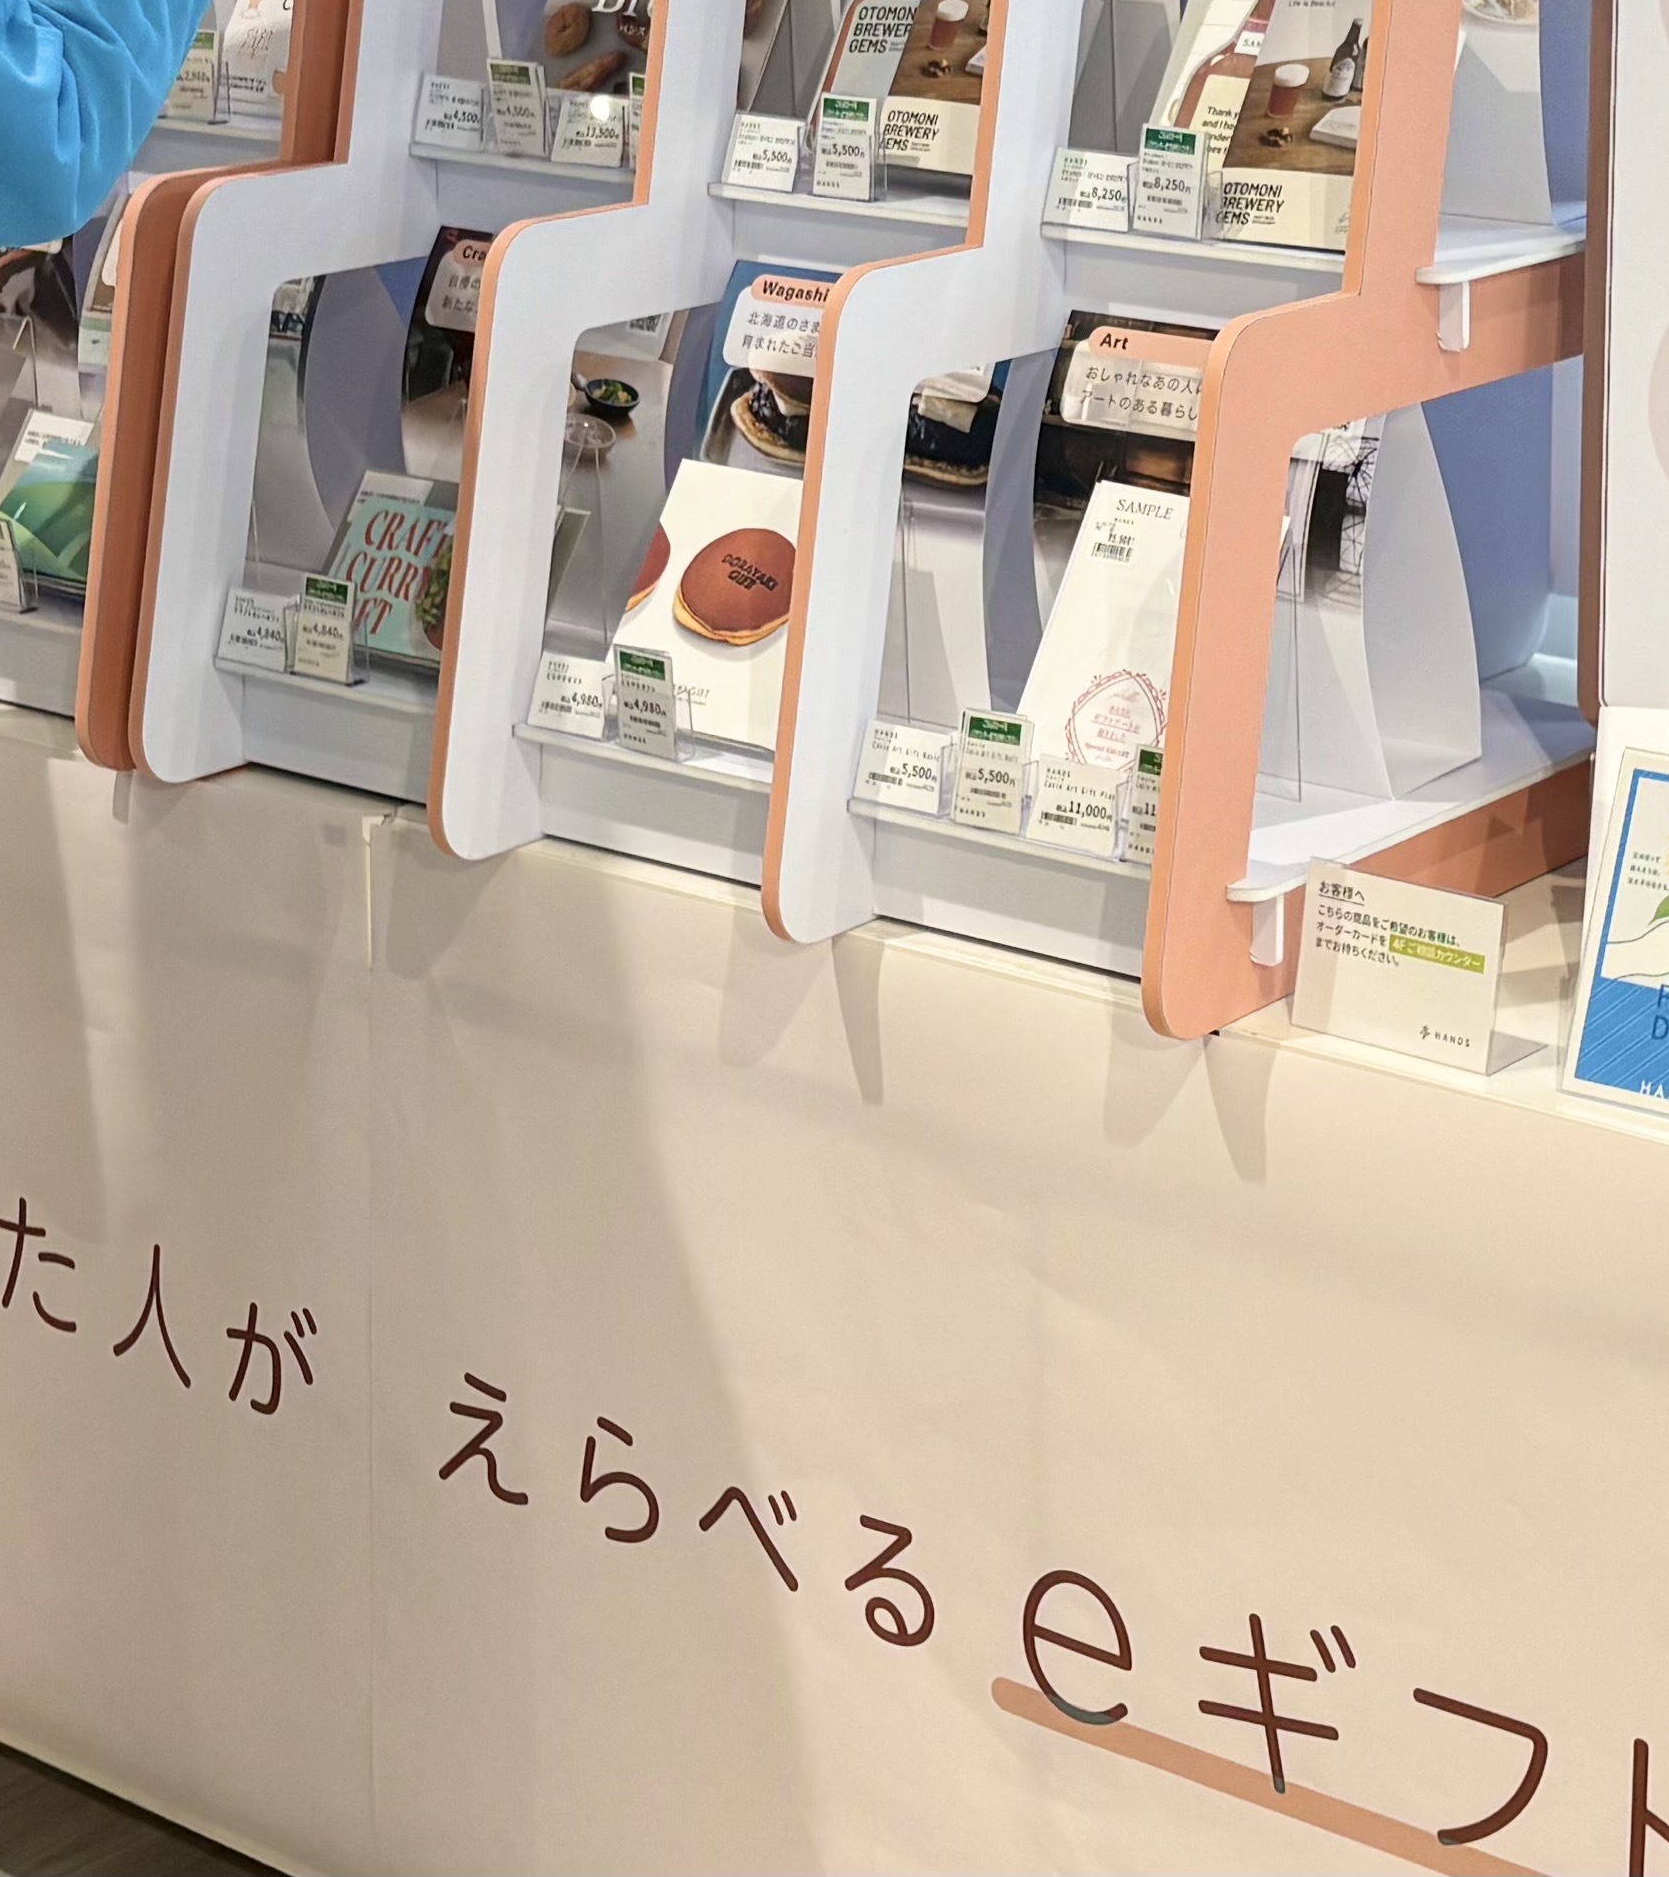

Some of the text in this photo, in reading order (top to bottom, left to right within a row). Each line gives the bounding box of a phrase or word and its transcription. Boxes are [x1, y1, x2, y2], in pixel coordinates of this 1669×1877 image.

[858, 6, 918, 21] OTOMON
[853, 23, 912, 37] BREWER
[848, 39, 887, 53] GEMS
[887, 110, 939, 126] OTOMONI
[1207, 106, 1232, 118] Thank
[883, 123, 940, 141] BREWERY
[1223, 182, 1282, 199] OTOMONI
[762, 280, 830, 302] Wagashi
[742, 334, 817, 358] 育まれたご当
[1099, 332, 1129, 351] Art
[1115, 498, 1174, 520] SAMPLE
[364, 509, 448, 559] CRAFT
[1319, 881, 1365, 902] お客様へ
[1317, 921, 1387, 947] オーダーカードを
[1434, 1030, 1471, 1048] HANDS
